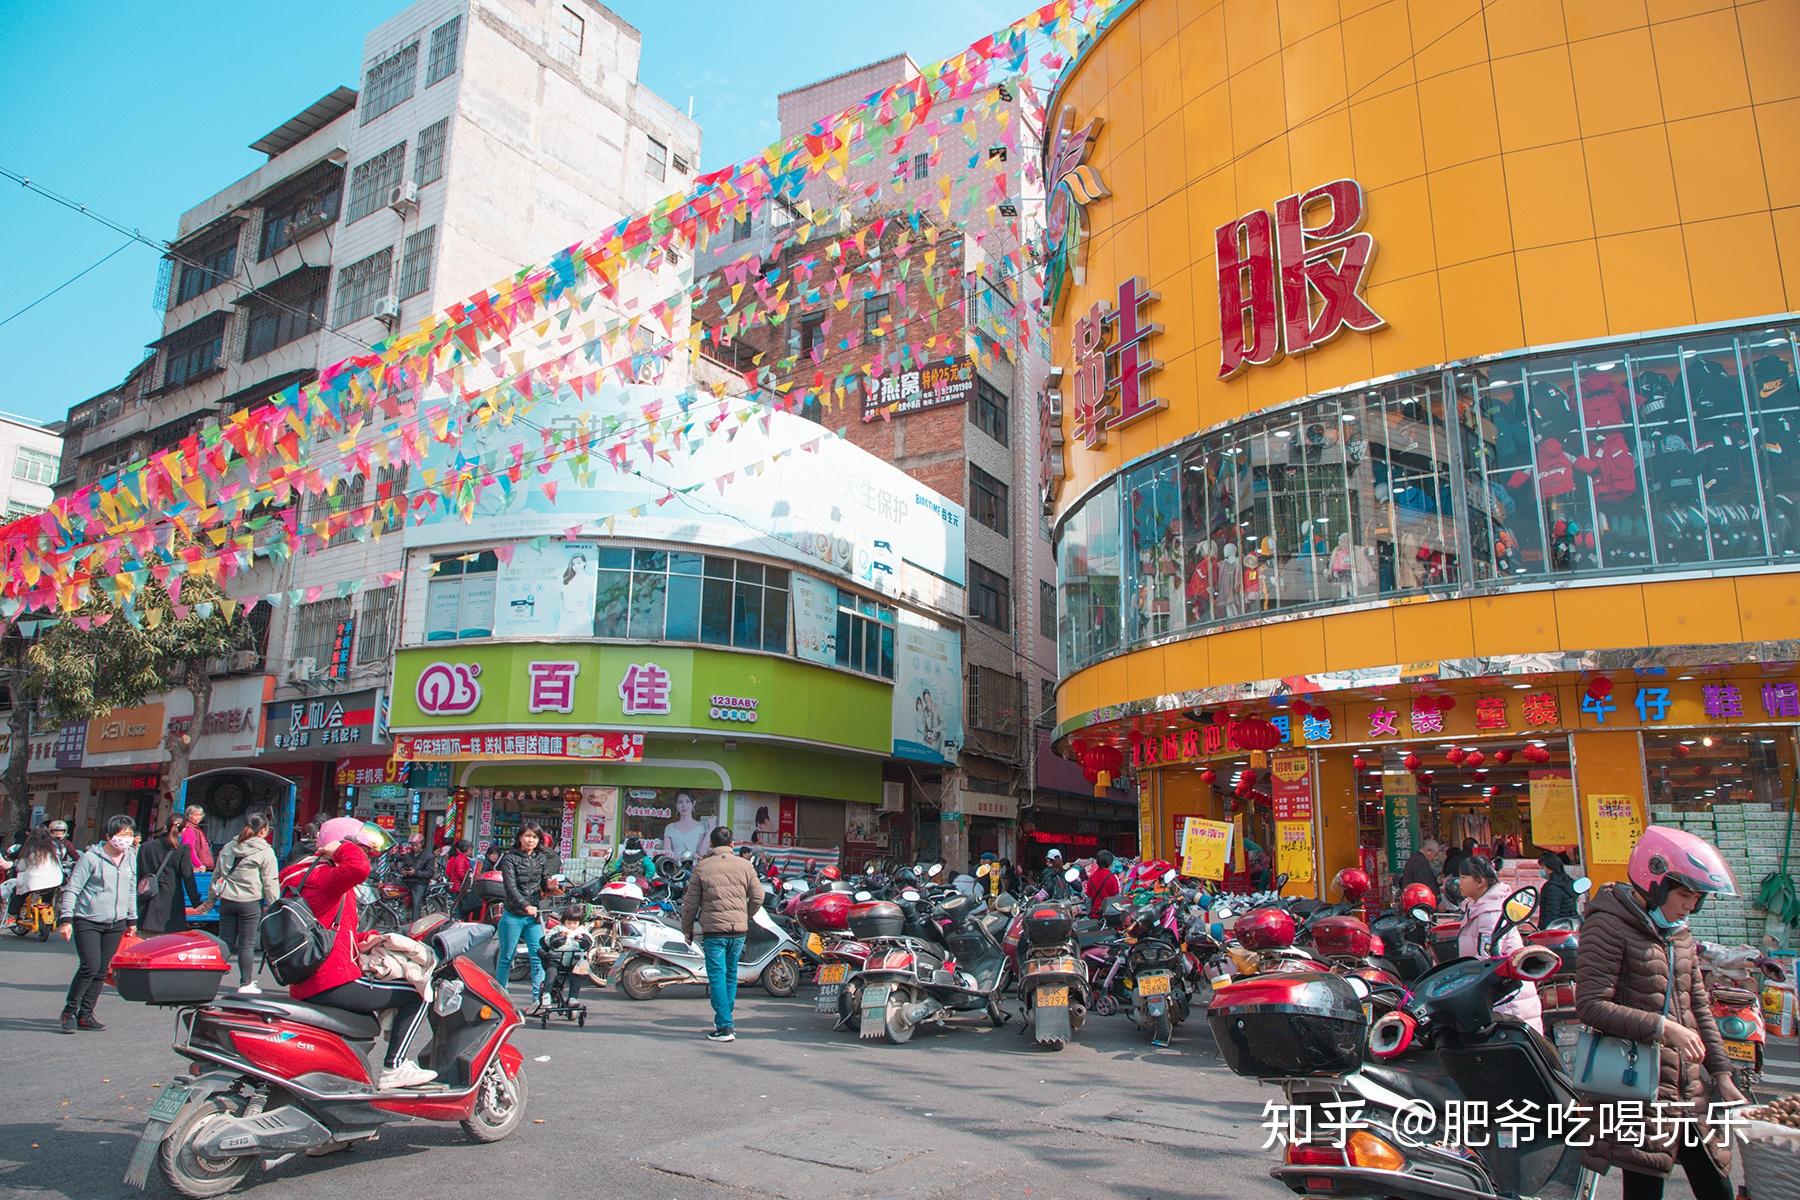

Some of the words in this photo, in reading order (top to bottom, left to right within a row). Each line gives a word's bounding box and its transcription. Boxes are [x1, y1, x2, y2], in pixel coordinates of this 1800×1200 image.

[528, 660, 672, 715] 百佳
[711, 695, 758, 708] 123BABY
[1368, 704, 1445, 737] 女装
[1475, 691, 1560, 729] 童装
[1580, 686, 1673, 724] 牛仔
[1702, 681, 1800, 719] 鞋帽
[484, 735, 563, 755] 送礼还是送健康
